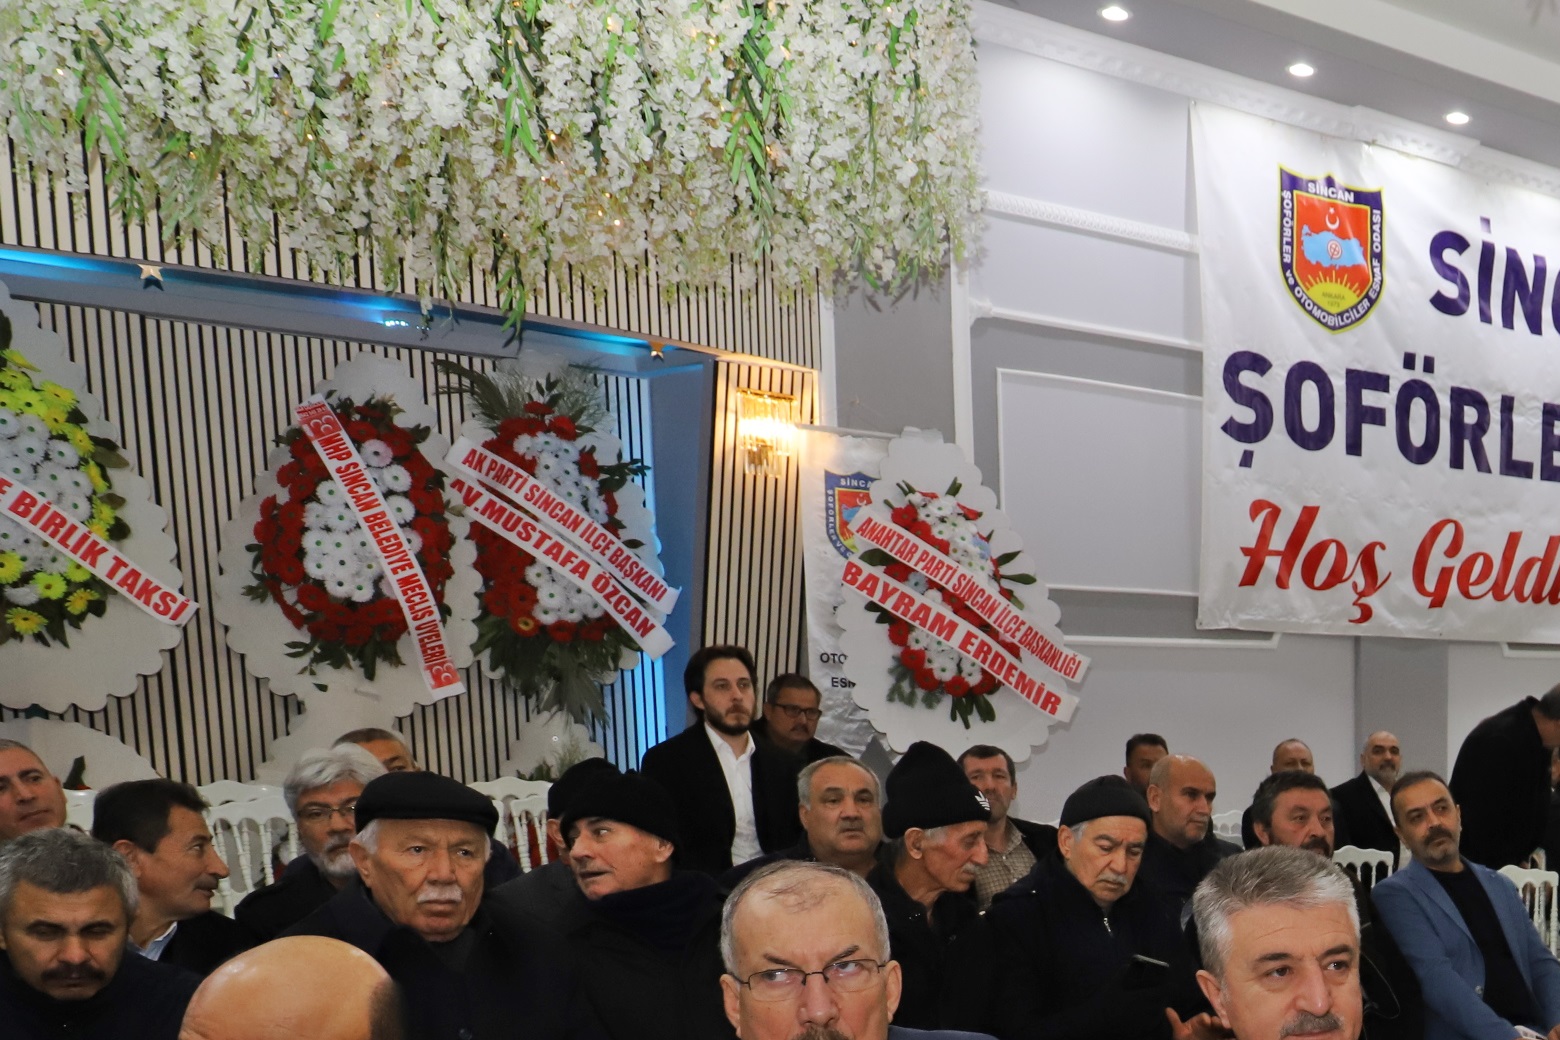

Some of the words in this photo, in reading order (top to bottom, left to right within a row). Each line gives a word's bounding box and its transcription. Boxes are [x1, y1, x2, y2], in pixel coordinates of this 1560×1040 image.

[1307, 181, 1354, 202] SİNCAN
[1282, 190, 1293, 263] ŞOFÖRLER
[1372, 209, 1381, 253] ODASI
[1294, 286, 1371, 327] OTOMOBİLCİLER
[1368, 259, 1381, 300] ESNAF
[318, 431, 353, 463] MHP
[335, 462, 381, 513] SİNCAN
[840, 478, 873, 489] SİNCA
[363, 510, 414, 576] BELEDİYE
[461, 448, 486, 471] AK
[486, 459, 530, 494] PARTİ
[524, 483, 586, 534] SİNCAN
[579, 521, 620, 556] İLÇE
[608, 549, 668, 602] BAŞKANI
[8, 490, 109, 569] BİRLİK
[105, 555, 190, 621] TAKSİ
[1238, 498, 1392, 624] Hoş
[397, 572, 438, 622] MECLİS
[591, 569, 656, 638] ÖZCAN
[856, 517, 916, 563] ANAHTAR
[914, 555, 958, 589] PARTİ
[953, 574, 1003, 619] SİNCAN
[997, 603, 1026, 638] İLÇE
[1019, 626, 1081, 679] BAŞKANLIĞI
[841, 560, 959, 642] BAYRAM
[958, 630, 1062, 716] ERDEMİR
